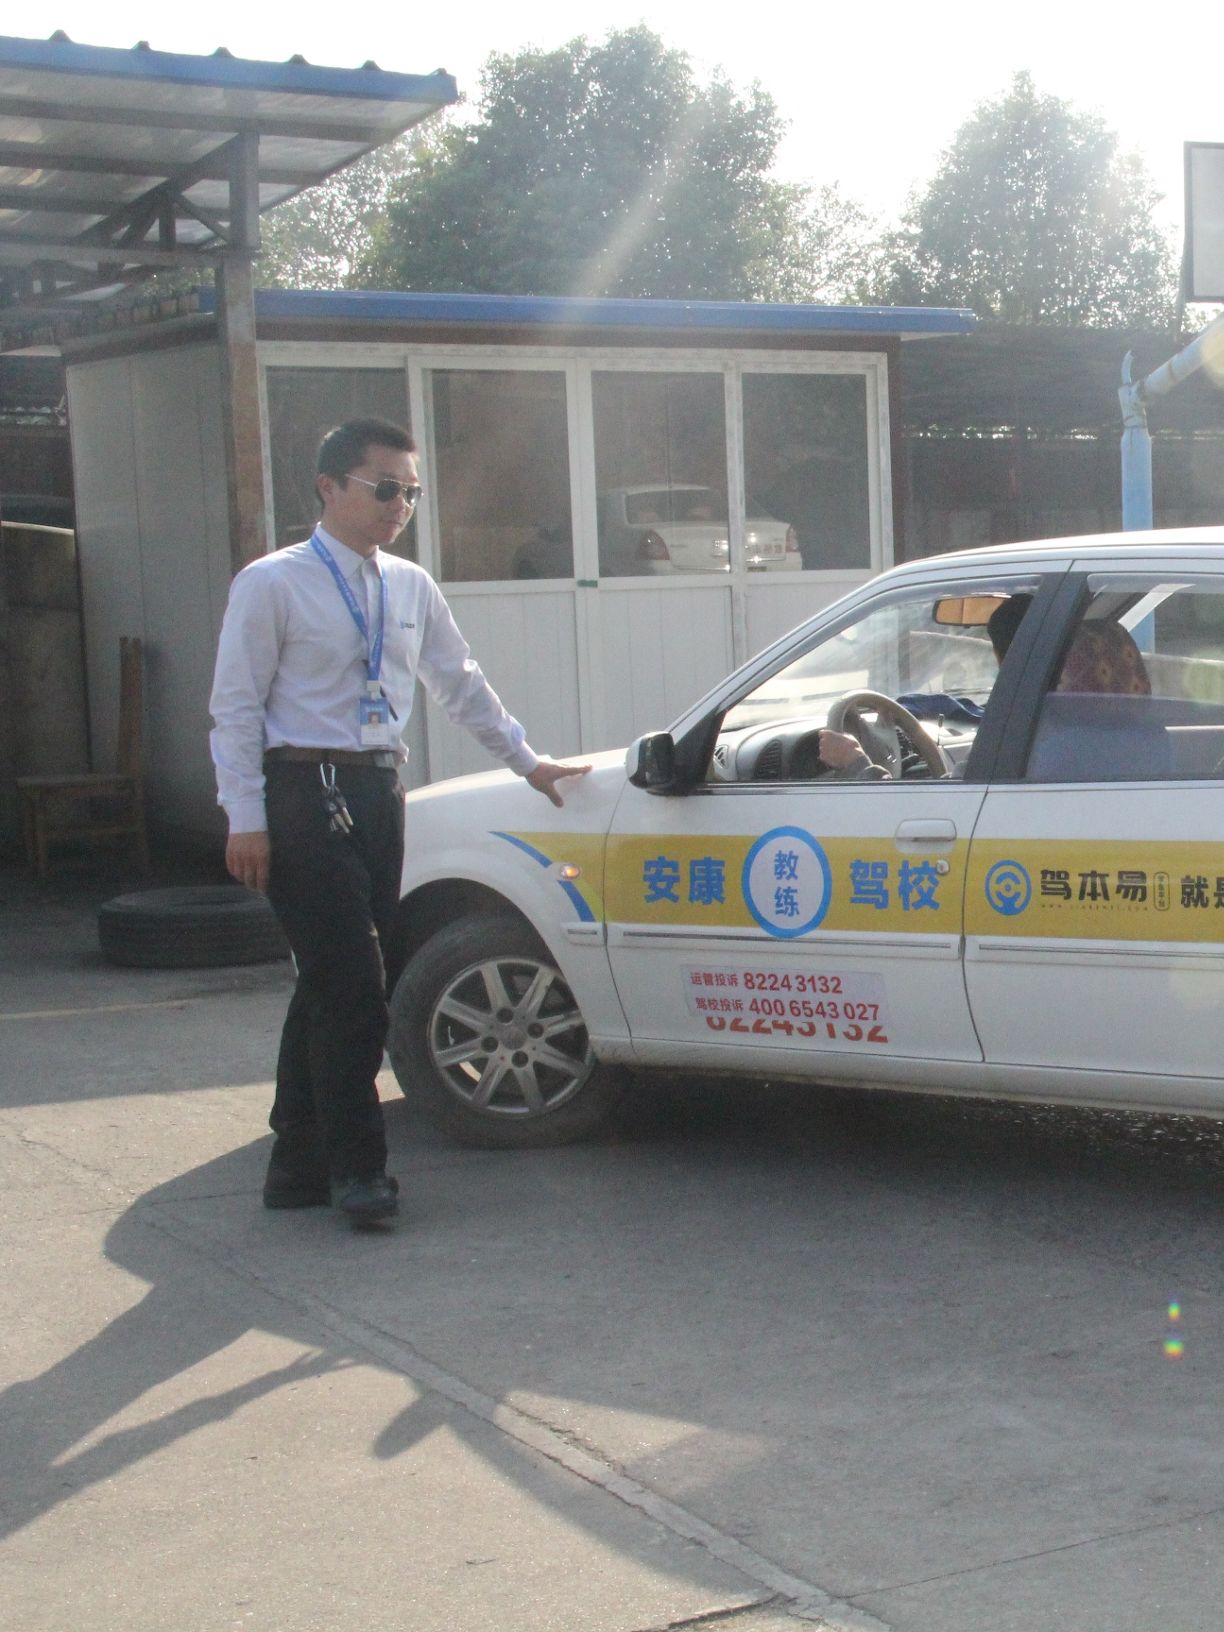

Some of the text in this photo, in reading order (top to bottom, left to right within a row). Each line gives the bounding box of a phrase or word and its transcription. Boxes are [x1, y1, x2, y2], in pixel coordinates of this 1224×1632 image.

[643, 850, 940, 916] 安康 教练 驾校
[1040, 869, 1148, 903] 驾本易
[695, 997, 744, 1012] 驾校投诉
